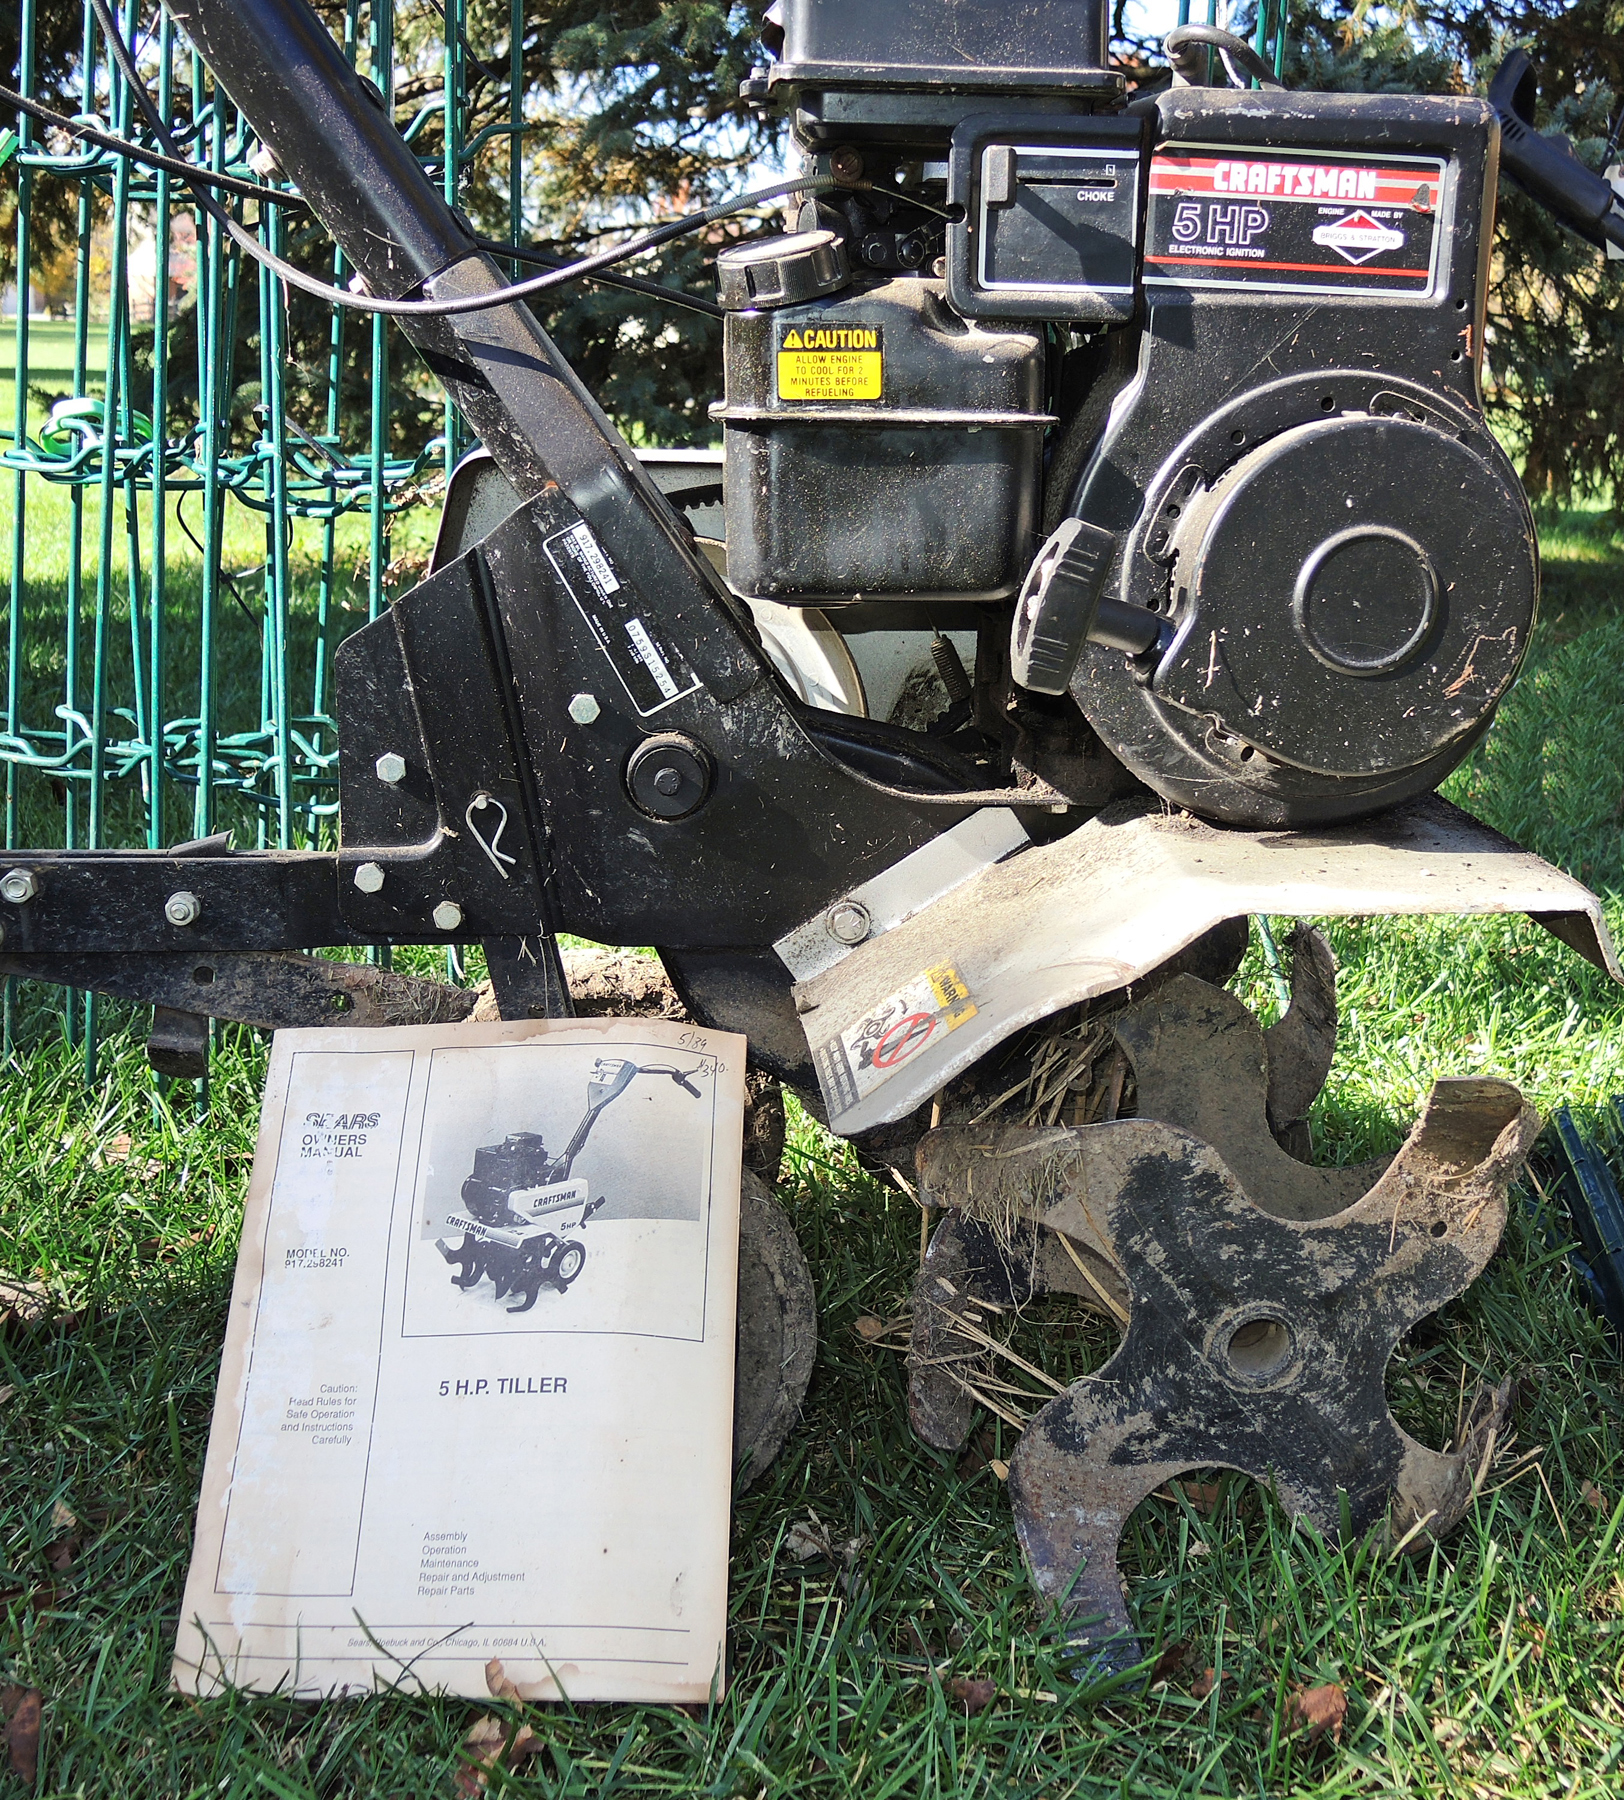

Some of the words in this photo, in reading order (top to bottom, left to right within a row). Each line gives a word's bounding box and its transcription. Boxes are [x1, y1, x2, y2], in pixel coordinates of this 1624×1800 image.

[1213, 162, 1377, 199] CRAFTSMAN
[1077, 190, 1115, 202] CHOKE
[1317, 207, 1345, 215] ENGINE
[1370, 210, 1391, 219] MADE
[1393, 211, 1404, 219] BY
[1172, 203, 1201, 242] 5
[1206, 204, 1269, 245] HP
[1320, 232, 1347, 240] BRIGGS
[1359, 234, 1395, 243] STRATTON
[1168, 244, 1225, 256] ELECTRONIC
[1225, 247, 1265, 258] IGNITION
[803, 329, 877, 349] CAUTION
[795, 355, 827, 364] ALLOW
[830, 355, 863, 364] ENGINE
[795, 366, 806, 375] TO
[810, 366, 833, 375] COOL
[837, 366, 853, 375] FOR
[858, 366, 863, 375] 2
[790, 377, 831, 386] MINUTES
[835, 377, 869, 386] BEFORE
[805, 388, 854, 397] REFUELING
[579, 534, 612, 585] 917.298241
[628, 625, 671, 694] 0759S15254
[939, 975, 965, 1018] WARNG
[533, 1190, 577, 1208] CRAFTSMAN
[446, 1215, 488, 1236] CRAFTSMAN
[286, 1248, 327, 1259] MODEL
[330, 1247, 350, 1258] NO.
[320, 1384, 358, 1393] Caution:
[438, 1380, 450, 1396] 5
[455, 1379, 490, 1396] H.P.
[496, 1377, 568, 1394] TILLER
[288, 1396, 314, 1406] Read
[316, 1396, 342, 1406] Rules
[344, 1396, 357, 1405] for
[286, 1409, 308, 1419] Safe
[310, 1409, 355, 1420] Operation
[280, 1422, 300, 1432] and
[301, 1422, 354, 1432] Instructions
[311, 1435, 352, 1446] Carefully
[423, 1531, 468, 1543] Assembly
[421, 1545, 467, 1556] Operation
[420, 1559, 479, 1568] Maintenance
[418, 1572, 449, 1583] Repair
[451, 1572, 470, 1582] and
[471, 1571, 525, 1583] Adjustment
[417, 1585, 448, 1597] Repair
[450, 1585, 475, 1596] Parts
[347, 1638, 372, 1647] Sears,
[410, 1638, 426, 1647] and
[445, 1638, 480, 1648] Chicago,
[492, 1638, 518, 1646] 60684
